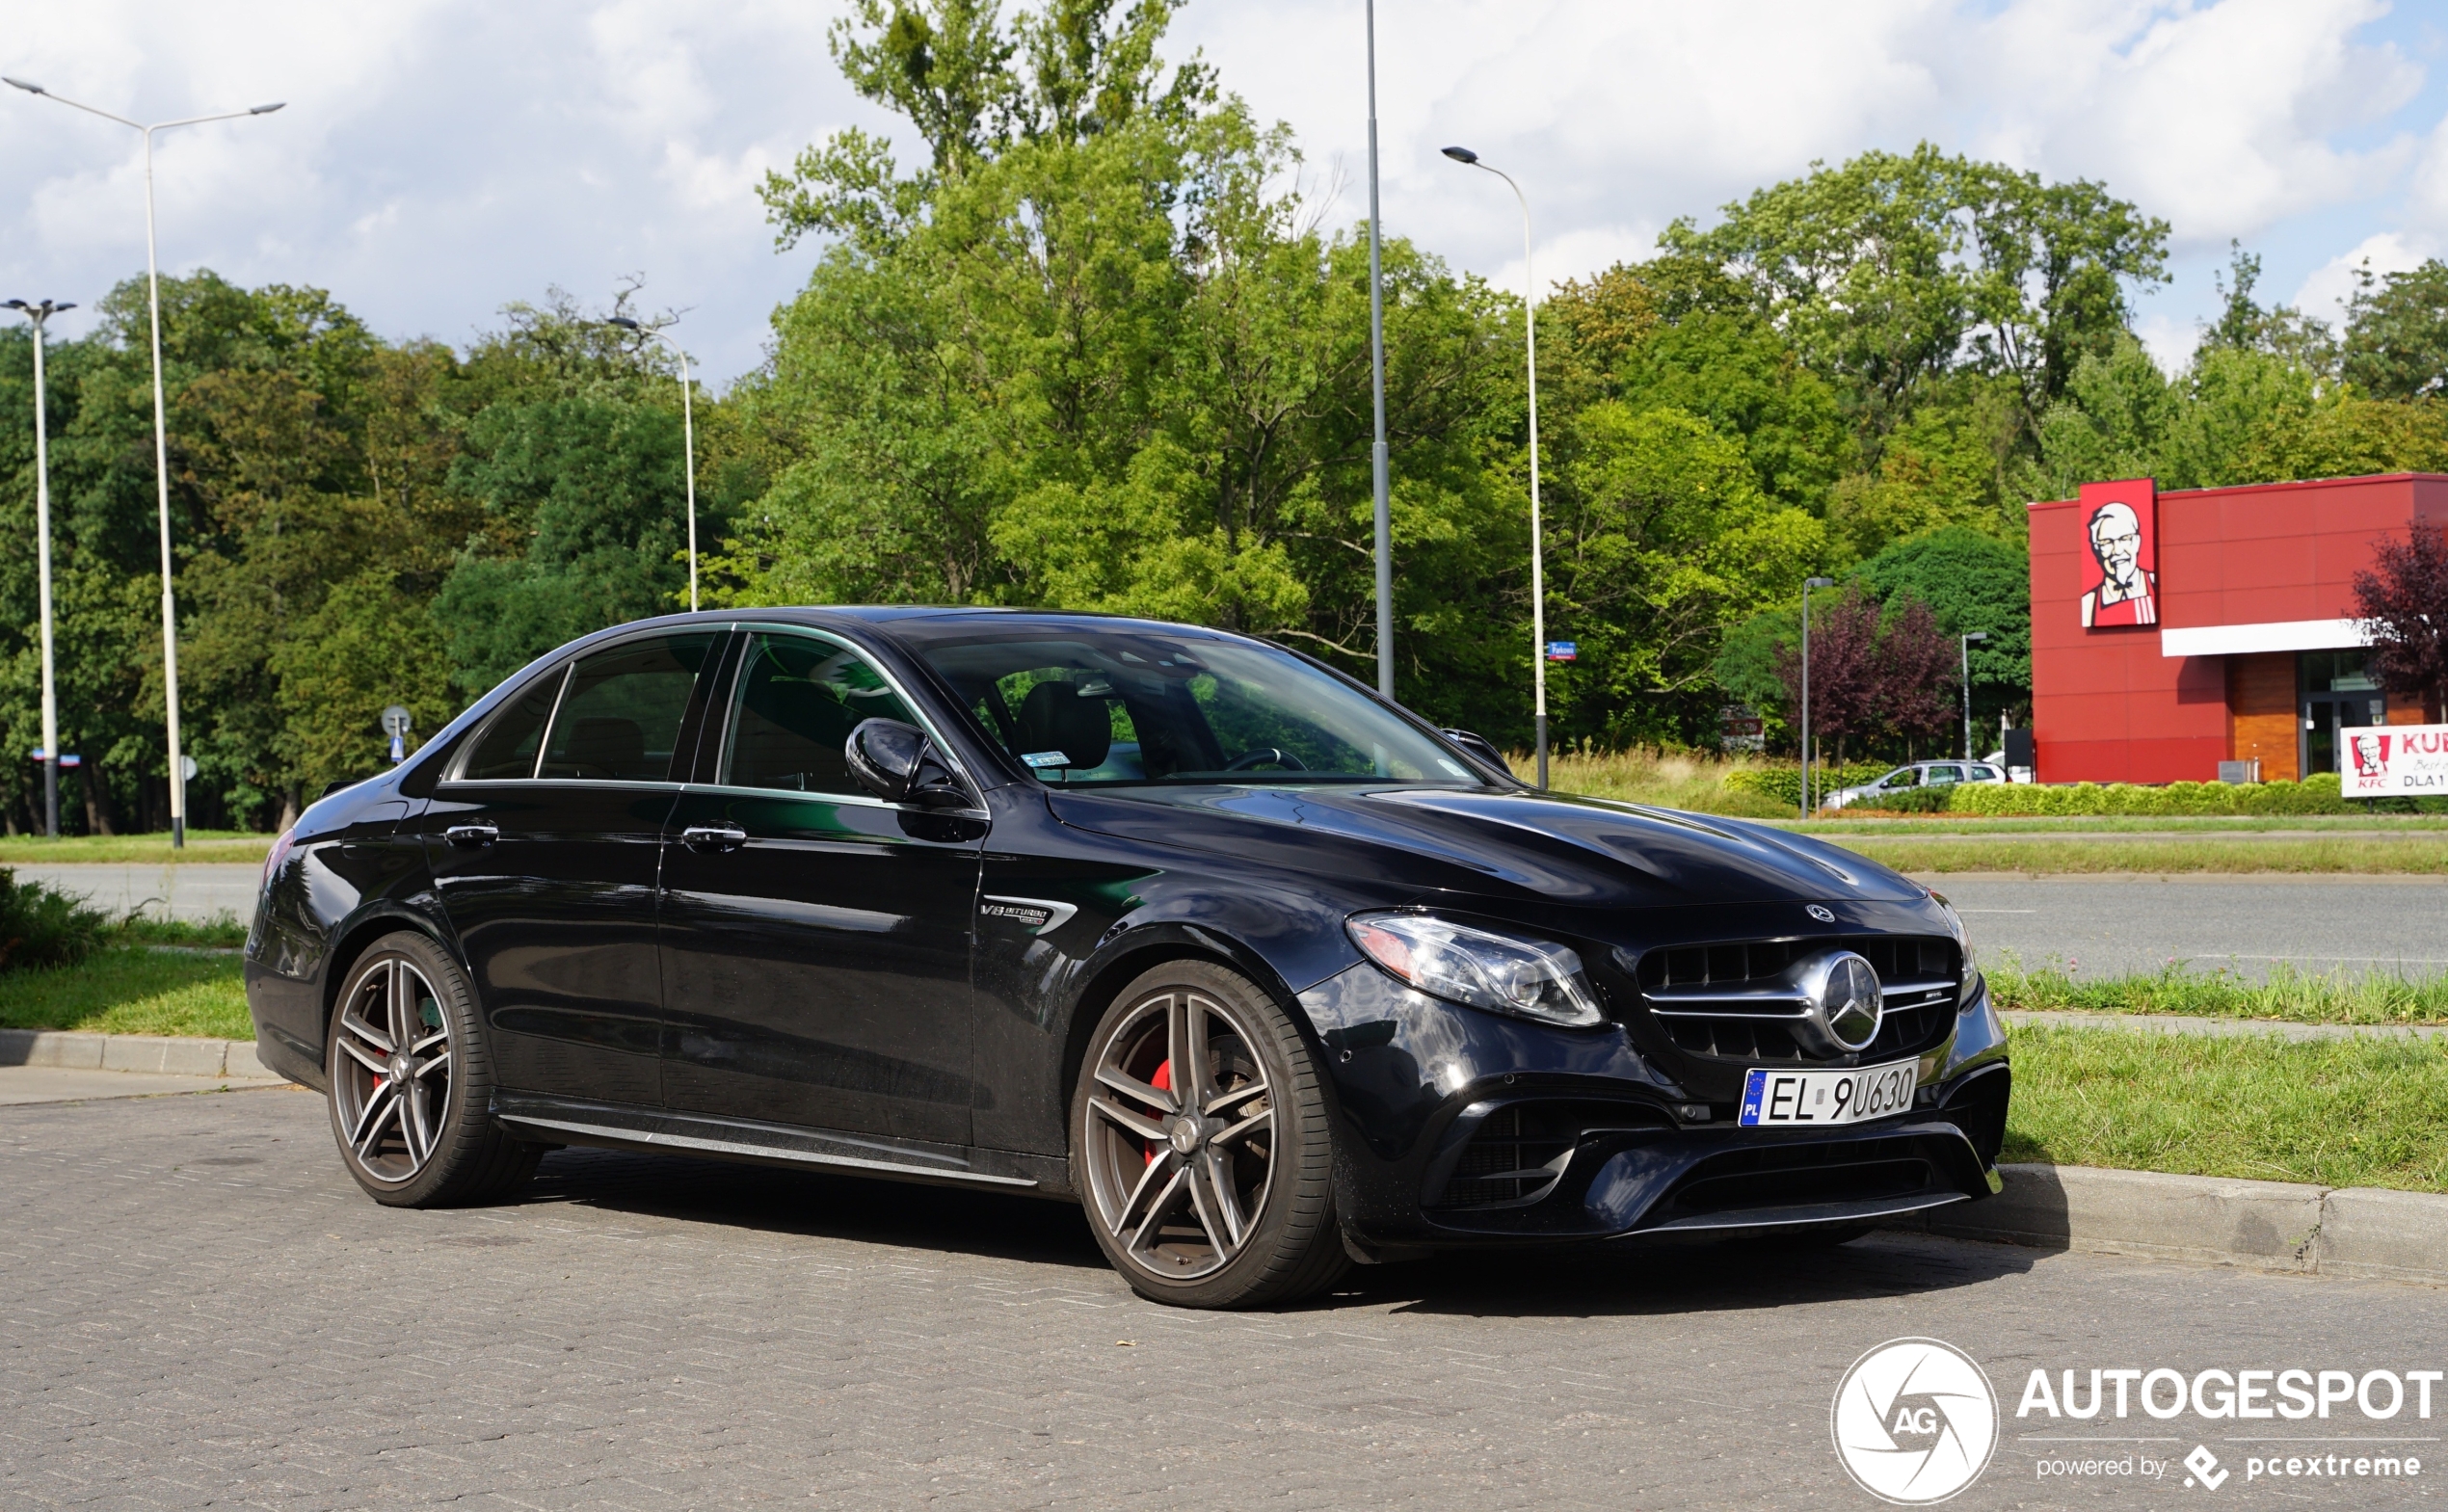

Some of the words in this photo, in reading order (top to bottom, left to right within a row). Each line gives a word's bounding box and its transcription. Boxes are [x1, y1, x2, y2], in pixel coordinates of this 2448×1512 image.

[2357, 779, 2387, 789] KFC
[2404, 775, 2435, 787] DLA
[980, 905, 1004, 915] V8
[1005, 907, 1048, 917] BITURBO
[1769, 1077, 1814, 1120] EL
[1830, 1067, 1913, 1120] 9U630
[1744, 1103, 1758, 1116] PL
